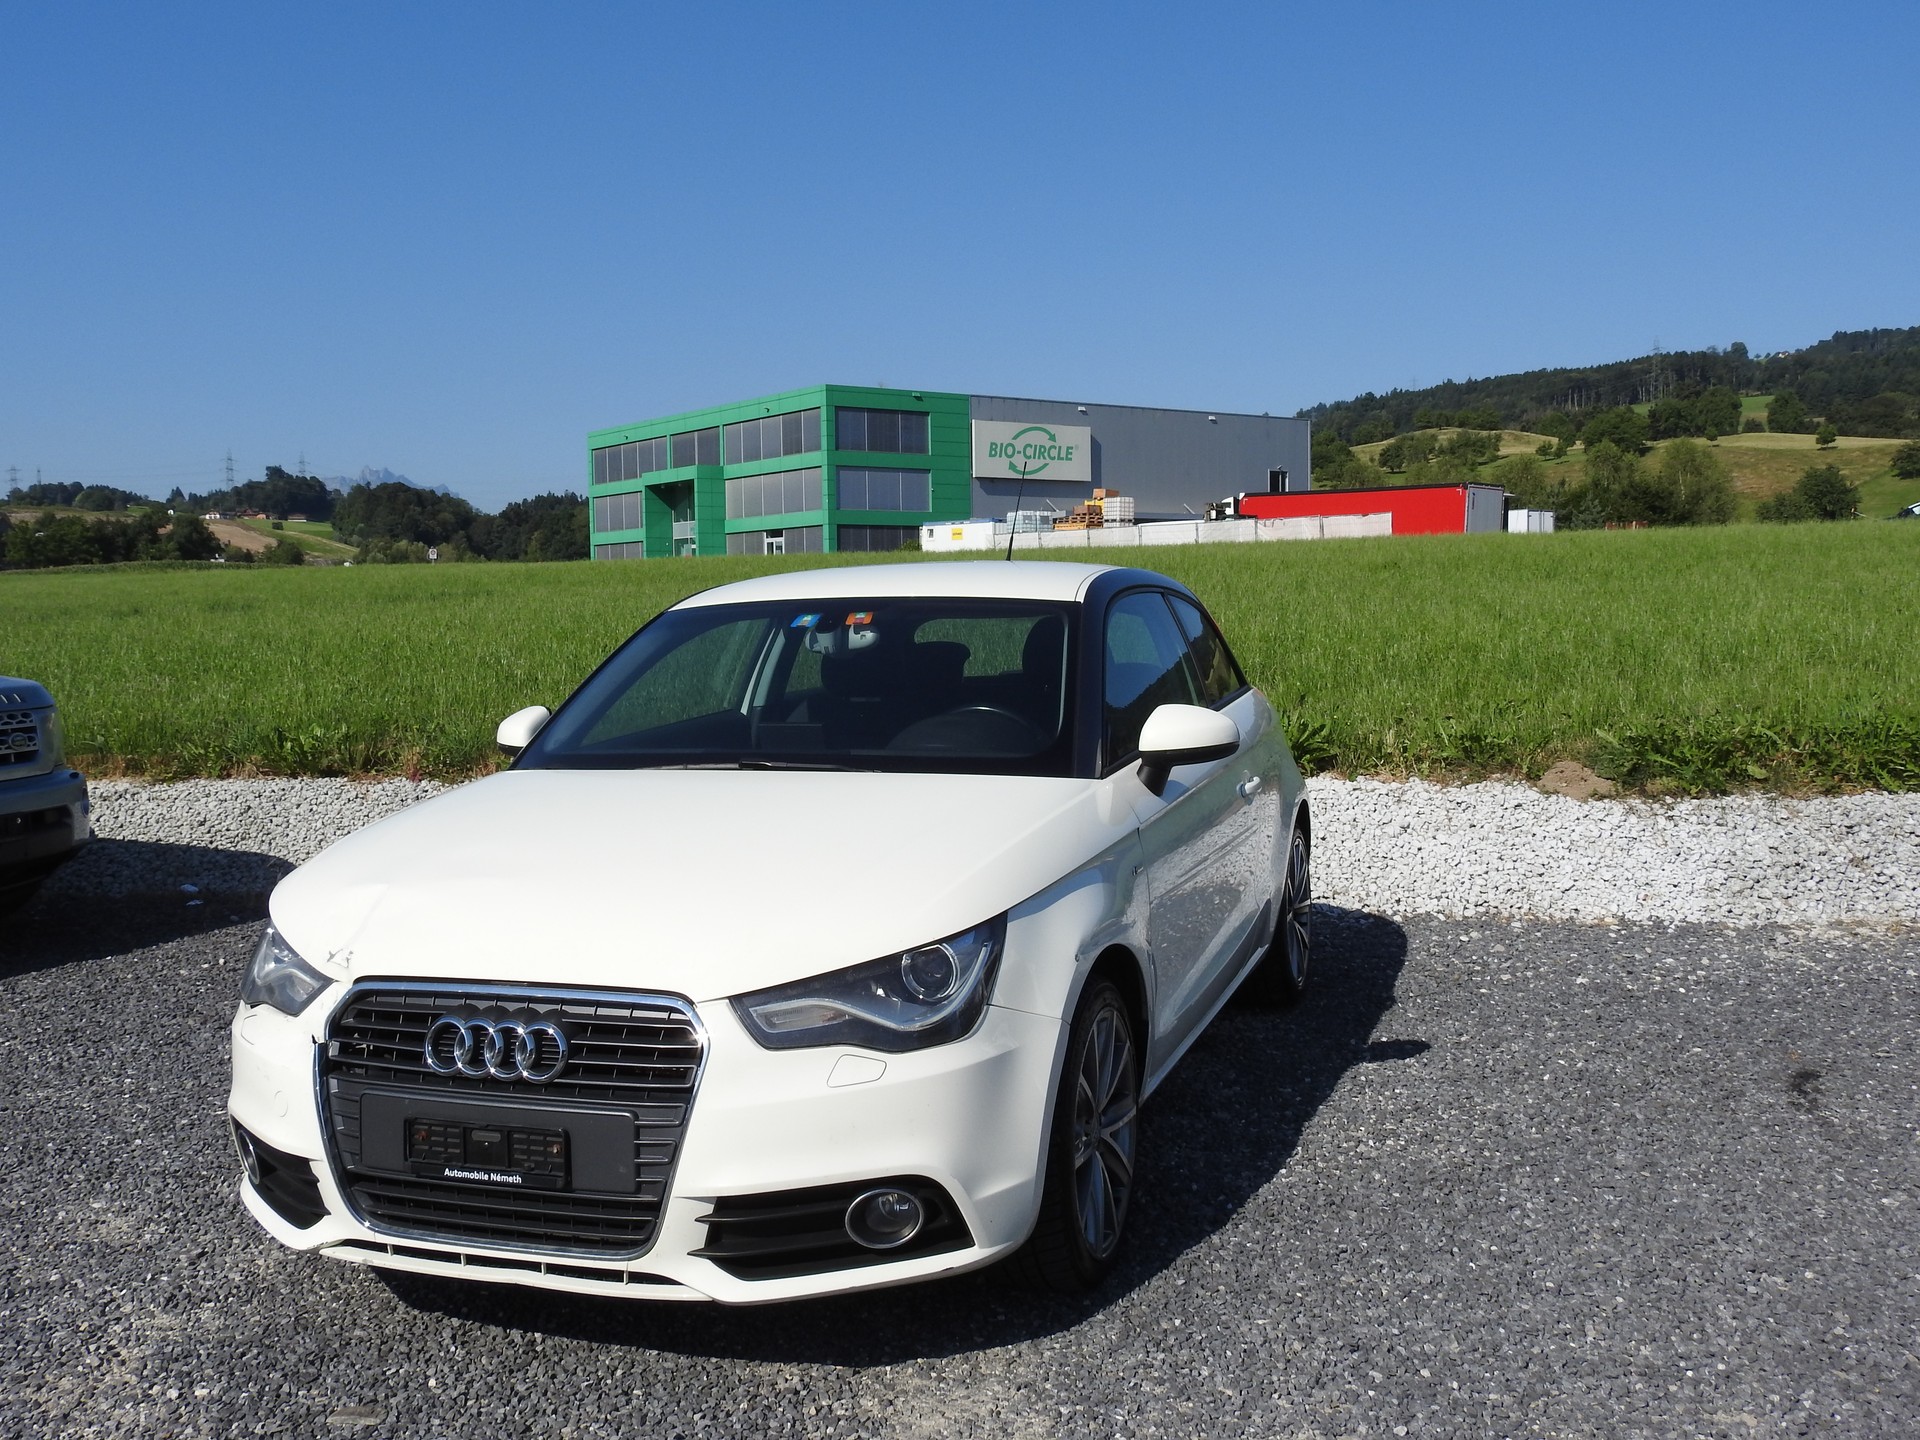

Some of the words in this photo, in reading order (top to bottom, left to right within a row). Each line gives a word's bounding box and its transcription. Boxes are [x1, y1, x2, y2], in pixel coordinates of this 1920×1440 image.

[988, 442, 1074, 461] BIO-CIRCLE
[444, 1168, 489, 1180] Automobile
[490, 1173, 521, 1184] Németh
